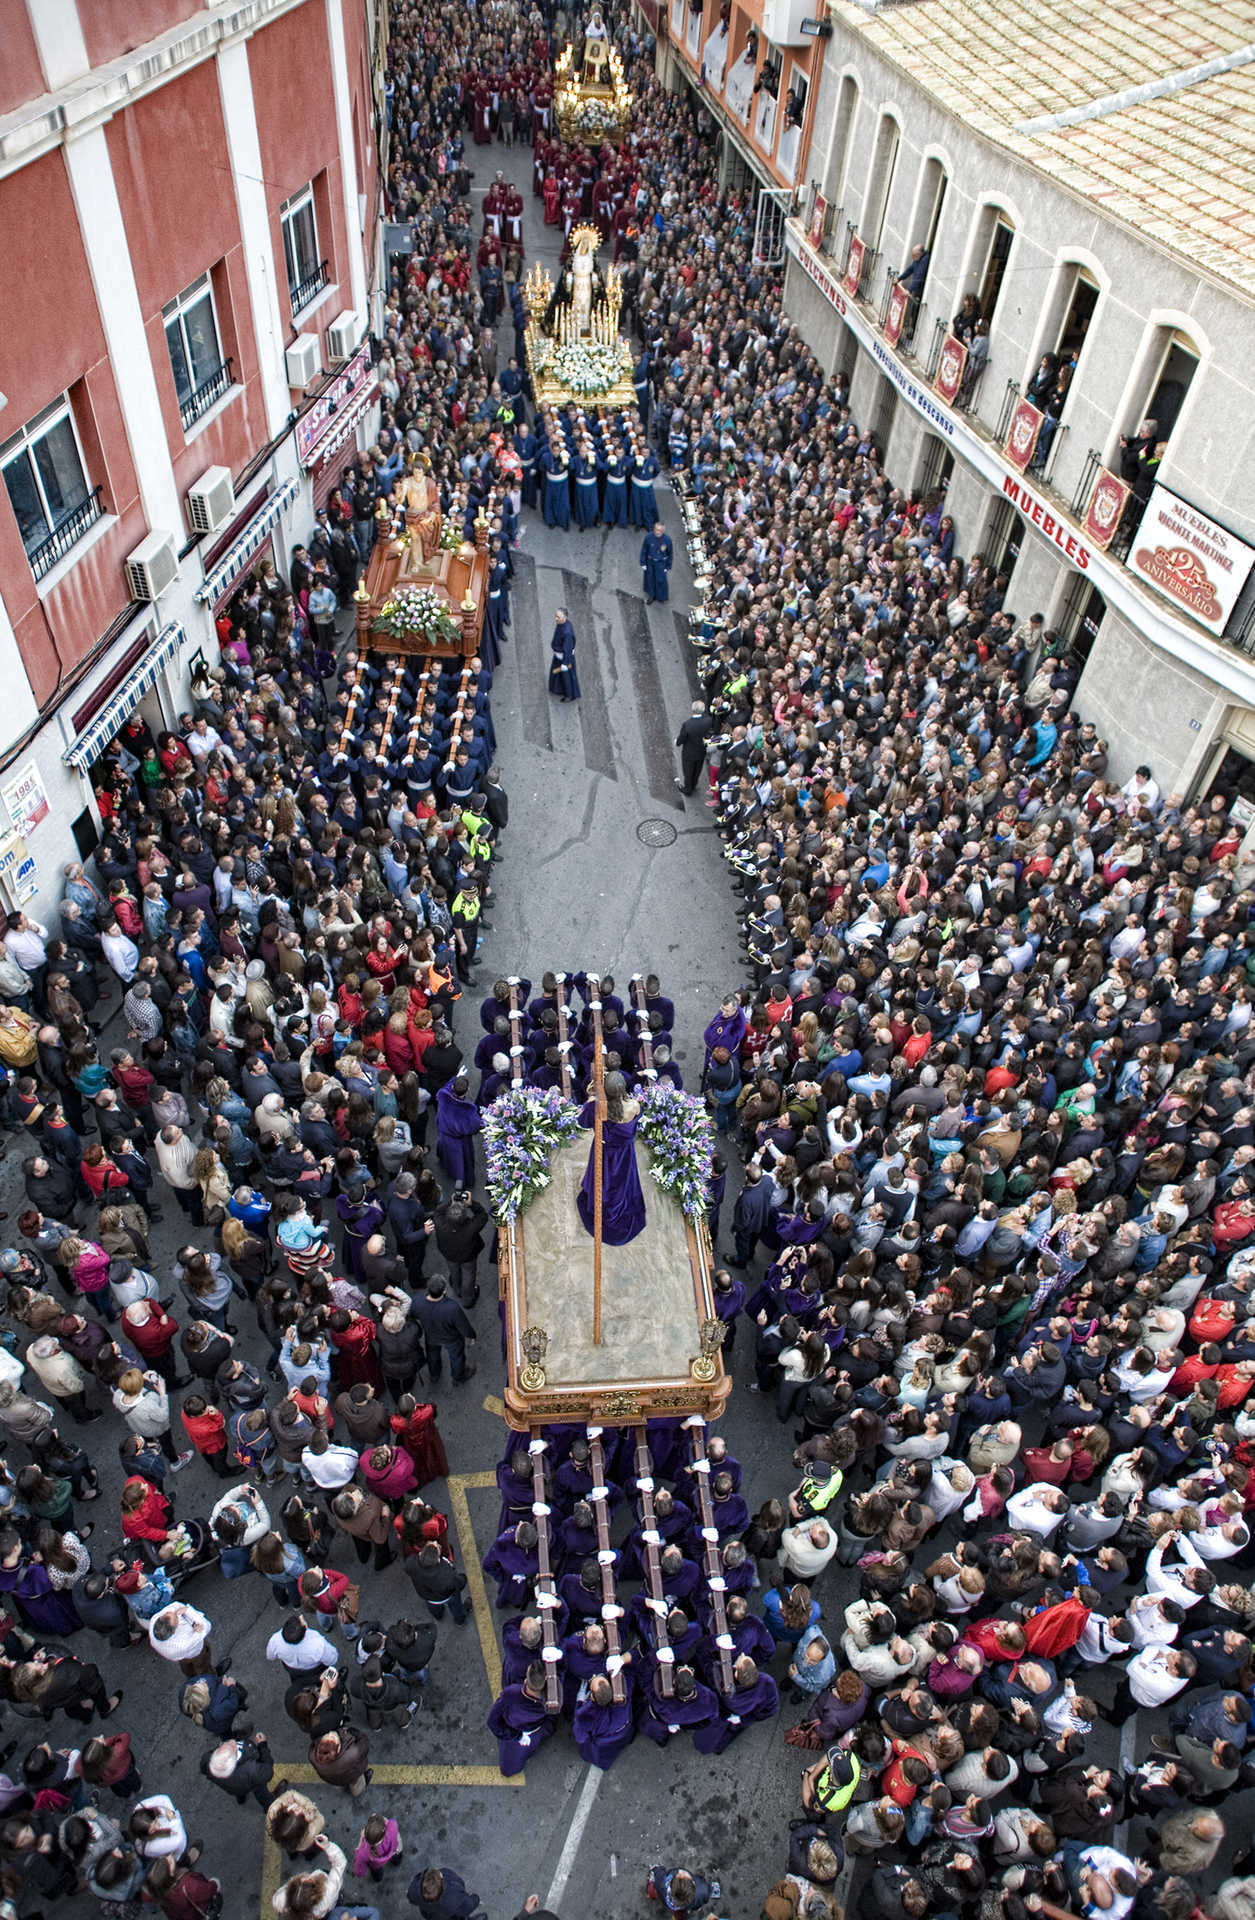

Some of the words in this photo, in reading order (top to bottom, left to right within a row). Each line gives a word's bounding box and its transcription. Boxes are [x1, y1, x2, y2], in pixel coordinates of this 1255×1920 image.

[799, 247, 847, 315] COLCHONES
[872, 340, 906, 389] especialistas
[908, 385, 918, 399] en
[918, 394, 954, 435] descanso
[1003, 475, 1091, 570] MUEBLES
[1158, 510, 1191, 543] VICENTE
[1171, 504, 1228, 549] MUEBLES
[1143, 561, 1213, 615] ANIVERSARIO
[1167, 552, 1204, 588] 125
[18, 857, 35, 880] API
